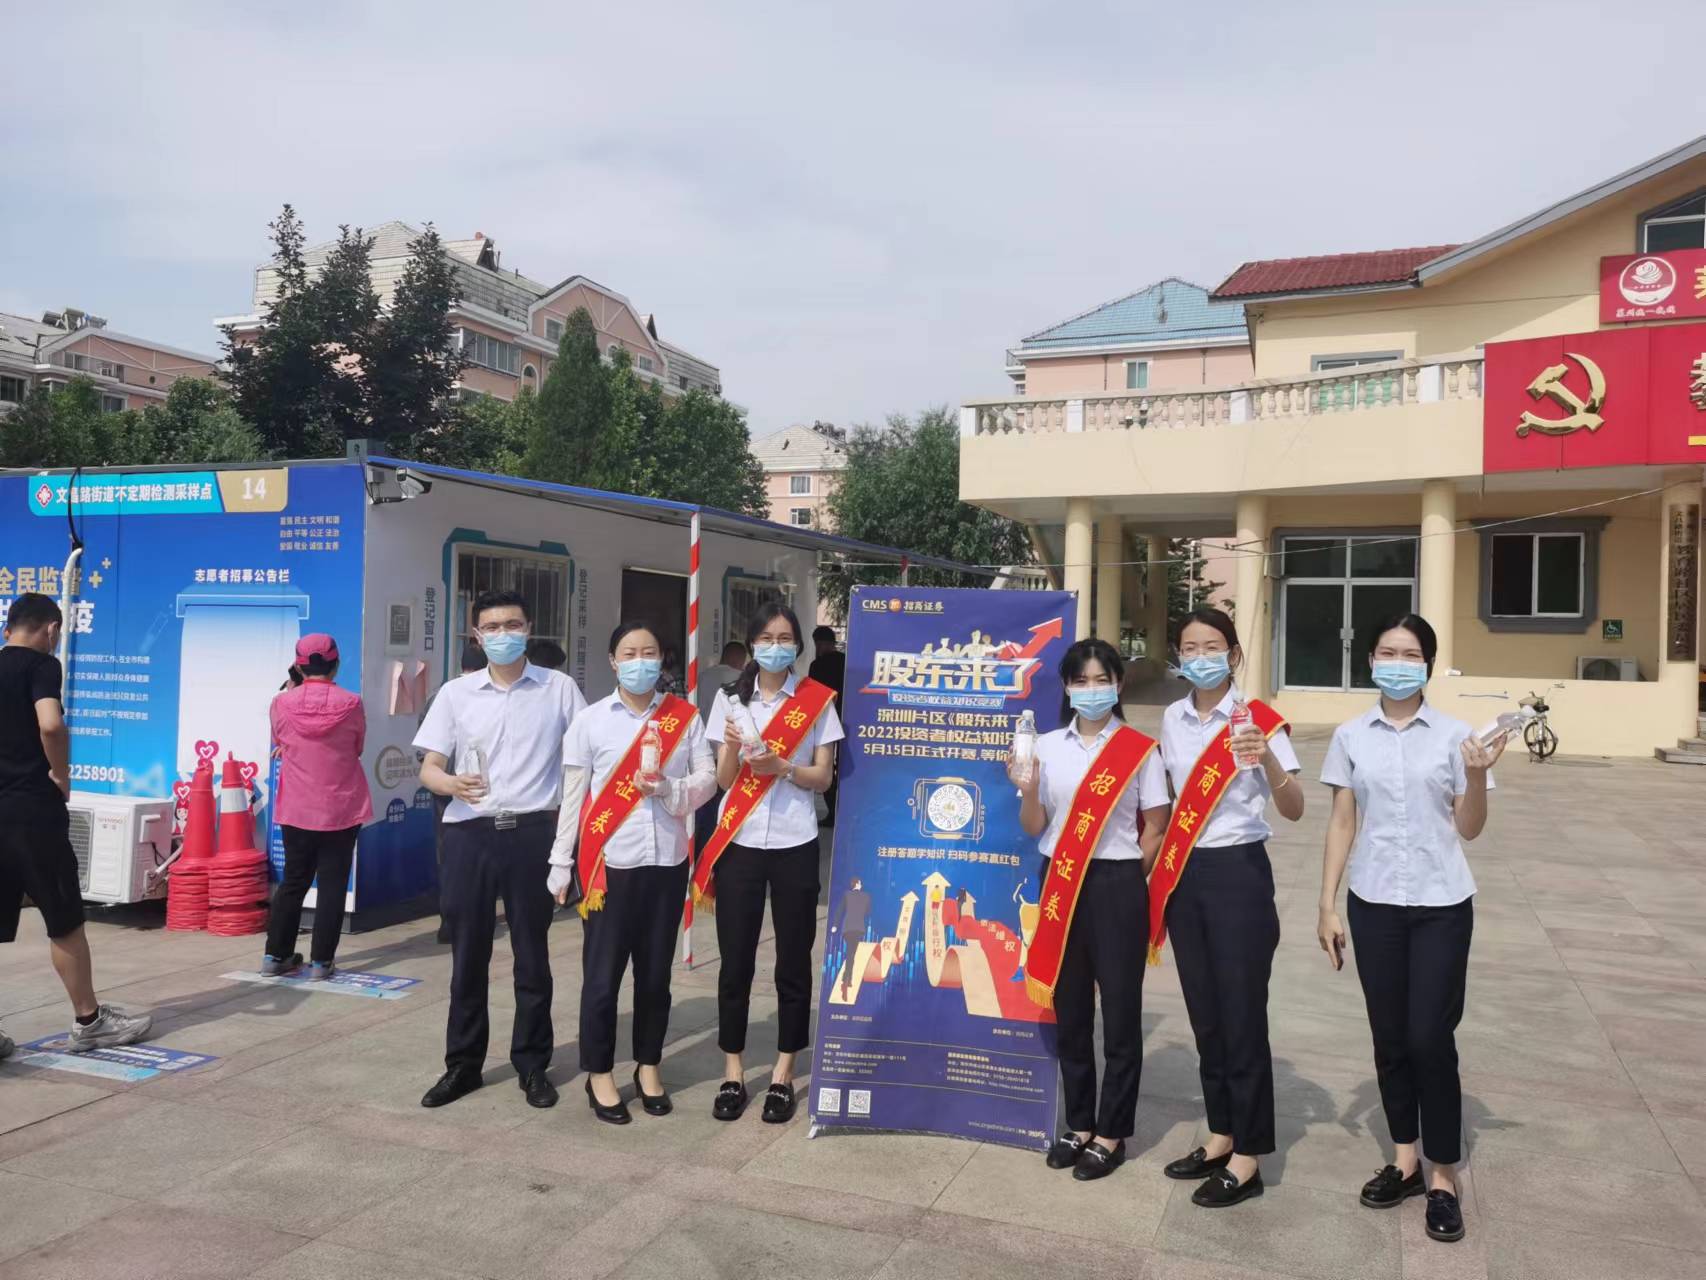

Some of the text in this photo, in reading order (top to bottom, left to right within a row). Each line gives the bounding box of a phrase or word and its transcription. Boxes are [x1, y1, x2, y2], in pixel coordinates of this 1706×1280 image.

[242, 477, 267, 499] 14
[194, 568, 290, 584] 志愿者招募公告栏
[862, 599, 887, 609] CMS
[424, 586, 437, 651] 登记窗口
[873, 652, 1037, 692] 股东来了
